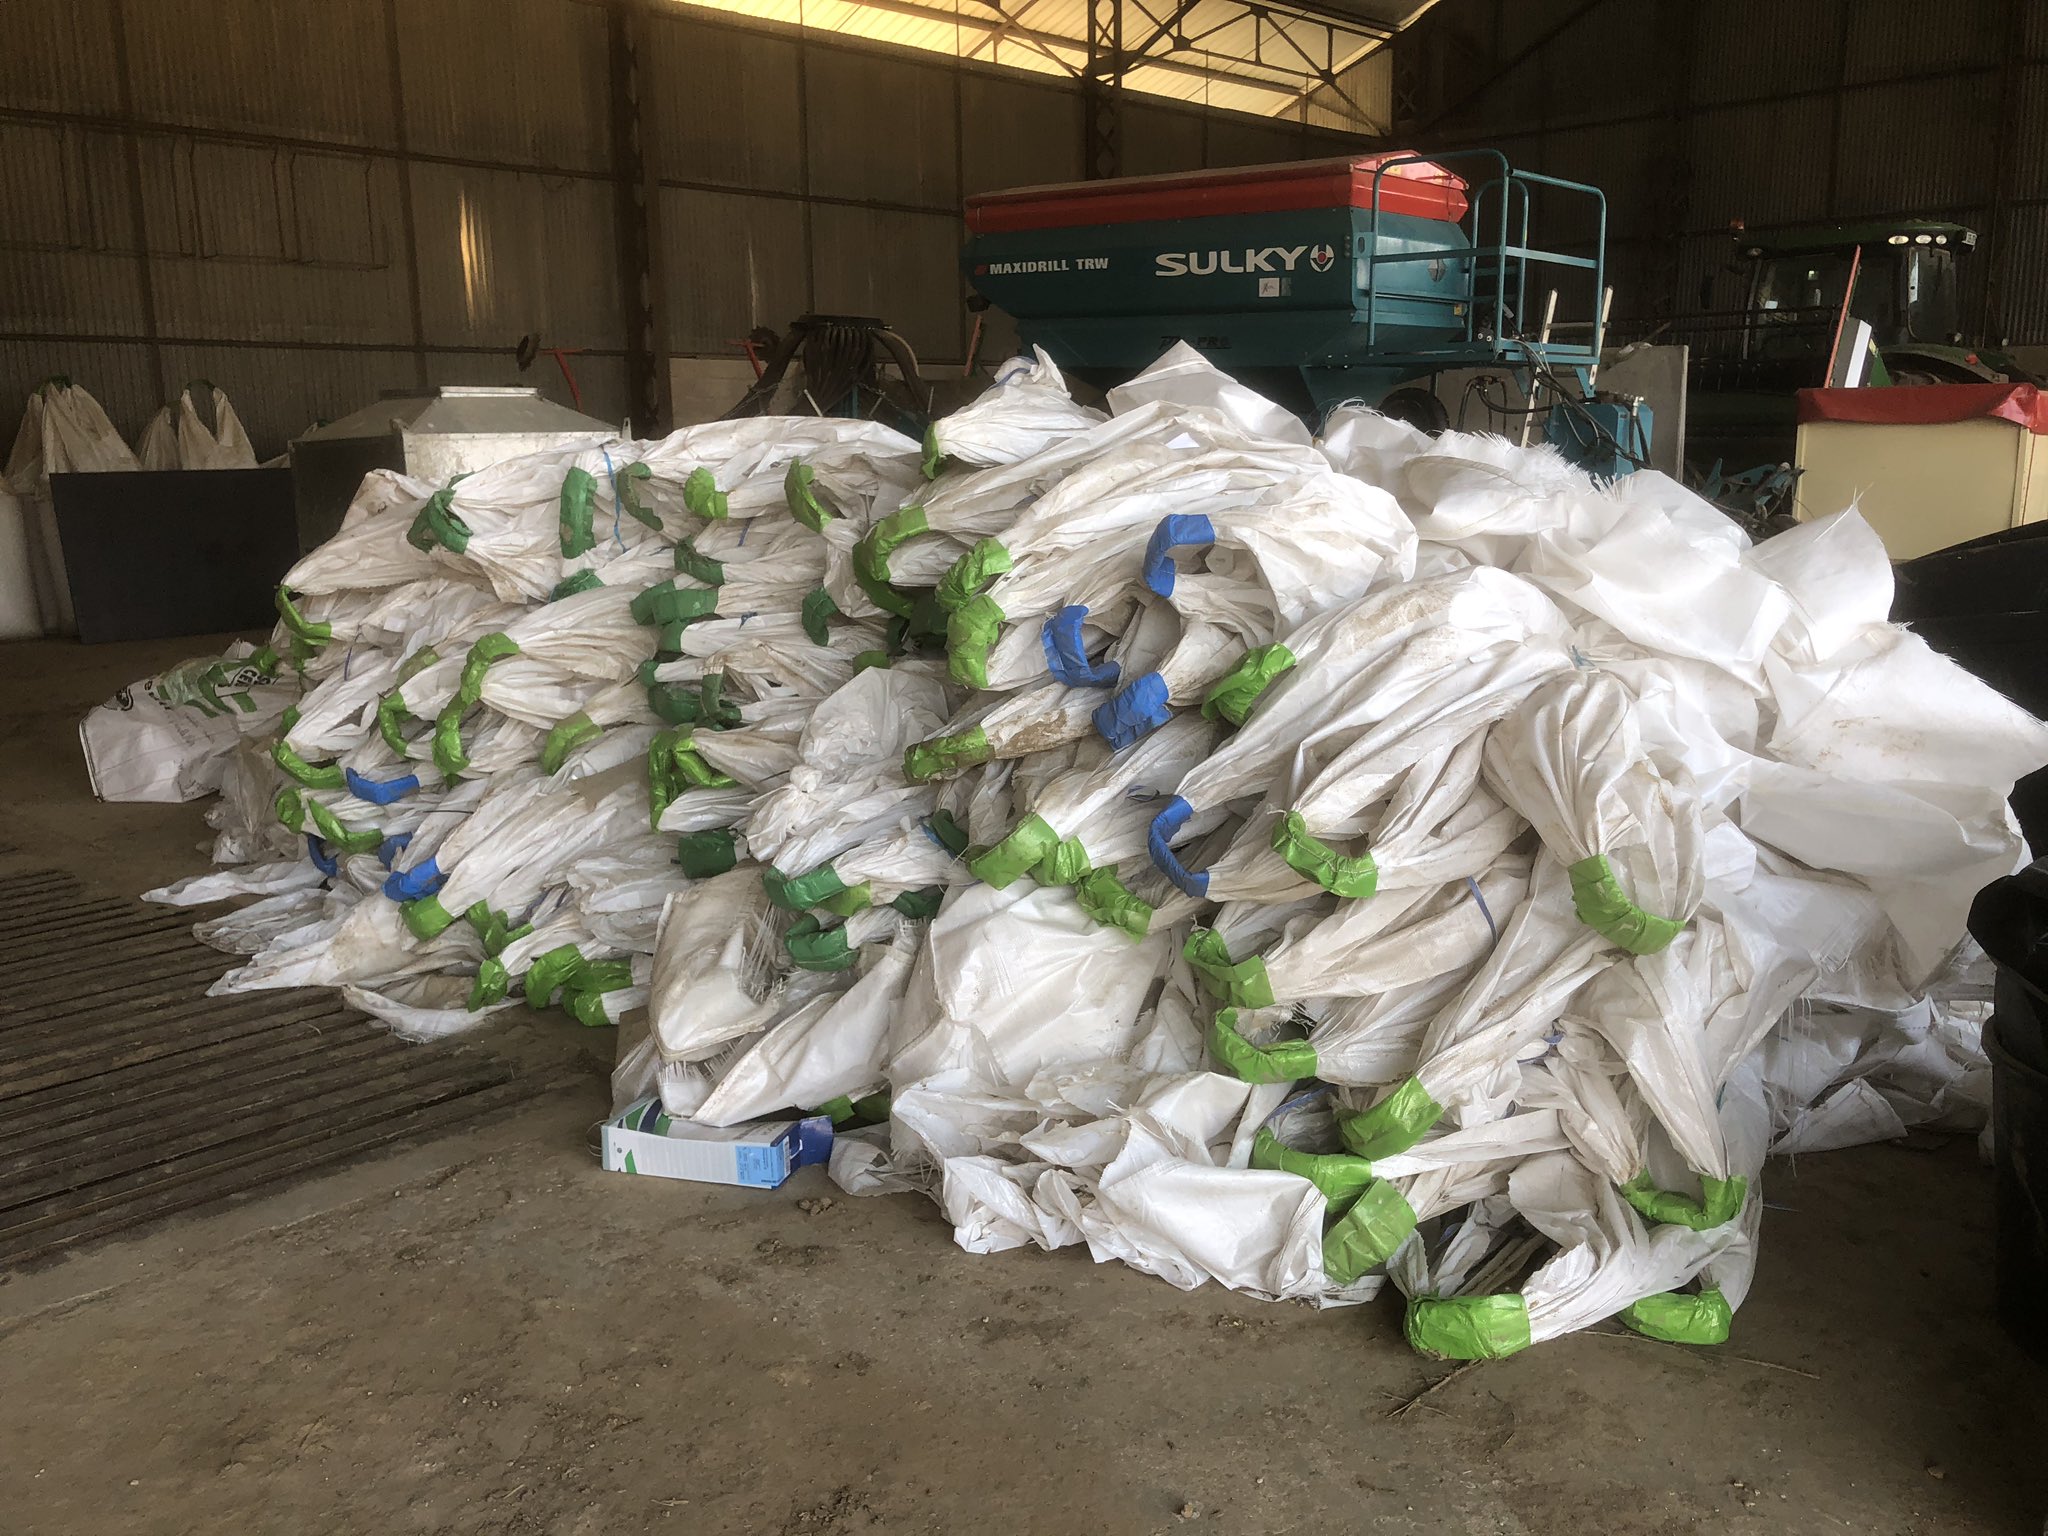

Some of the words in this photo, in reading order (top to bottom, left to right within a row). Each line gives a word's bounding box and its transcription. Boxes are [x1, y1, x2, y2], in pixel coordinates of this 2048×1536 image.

[990, 260, 1069, 274] MAXIDRILL
[1075, 257, 1109, 270] TRW
[1155, 245, 1308, 277] SULKY
